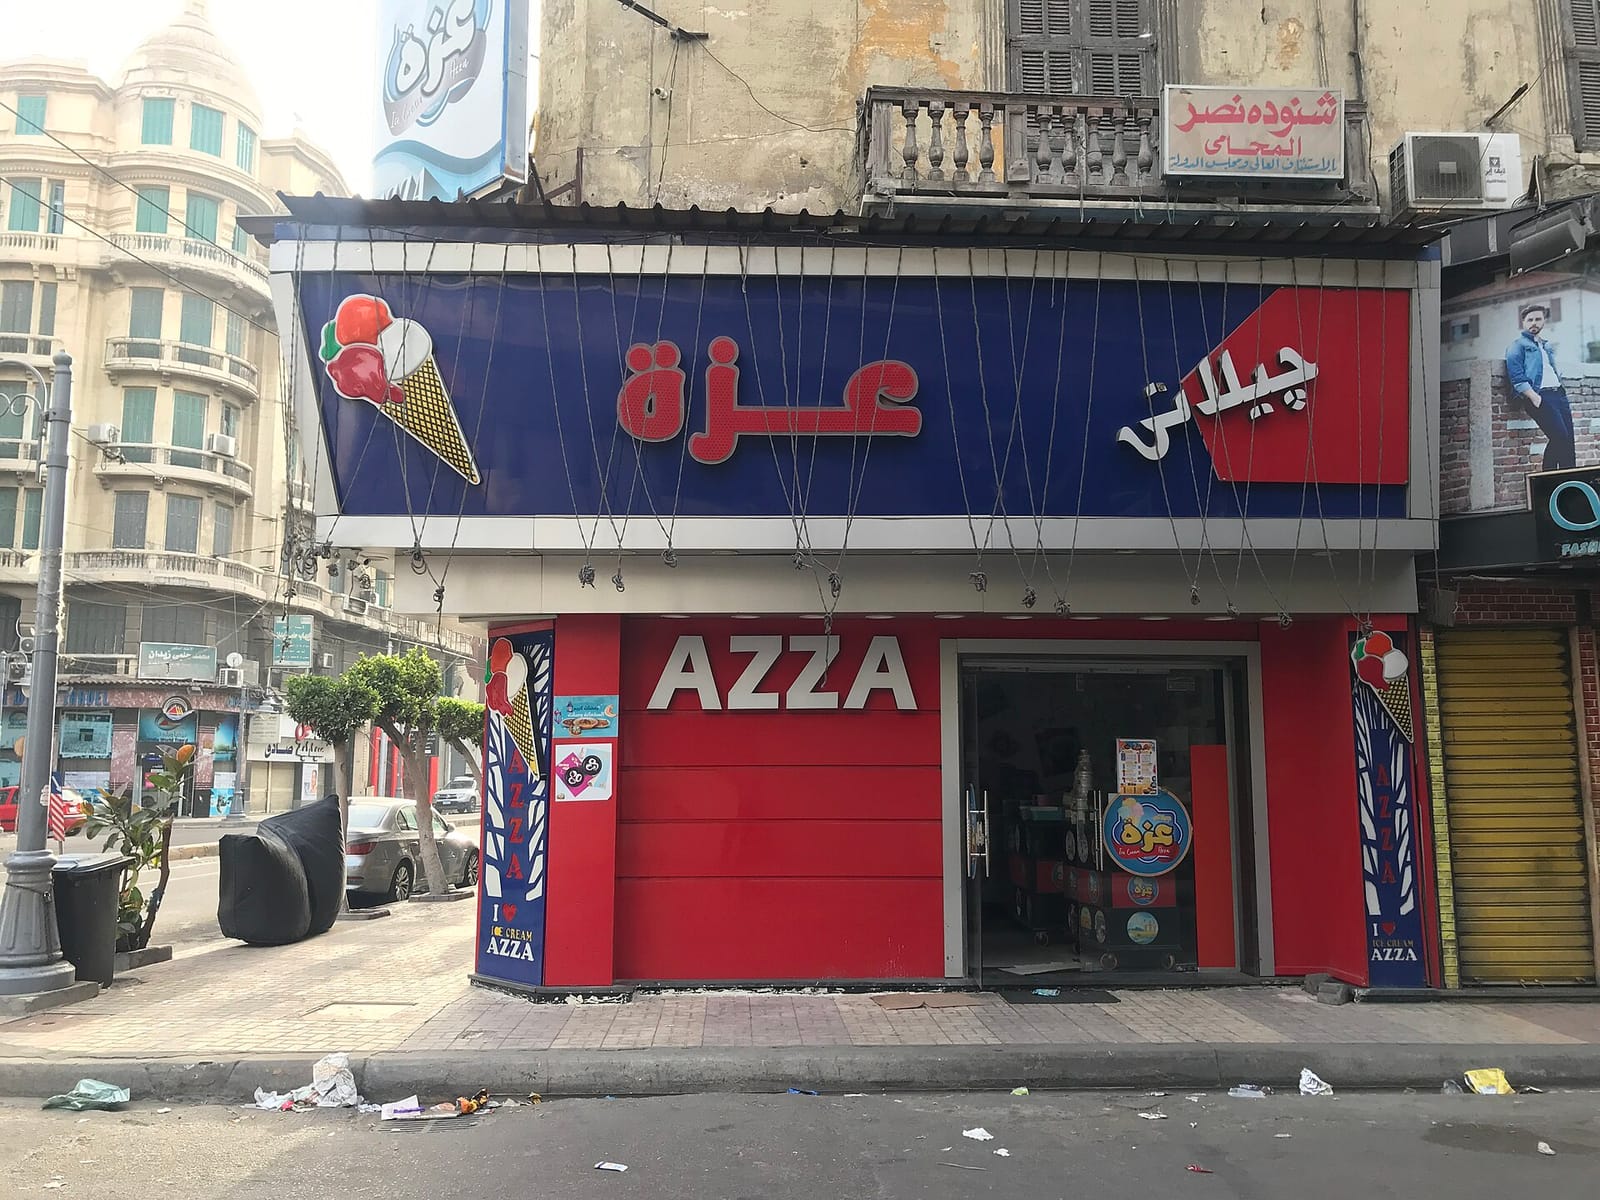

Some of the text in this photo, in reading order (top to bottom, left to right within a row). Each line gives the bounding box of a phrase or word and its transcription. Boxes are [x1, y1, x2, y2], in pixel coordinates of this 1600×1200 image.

[1175, 91, 1338, 138] شنوده نصر
[617, 335, 923, 465] عزة
[646, 635, 918, 710] AZZA
[506, 747, 526, 880] AZZA
[1120, 817, 1174, 853] عزة
[1376, 763, 1396, 884] AZZA
[486, 936, 535, 962] AZZA
[491, 925, 533, 942] ICE CREAM
[1371, 948, 1418, 961] AZZA
